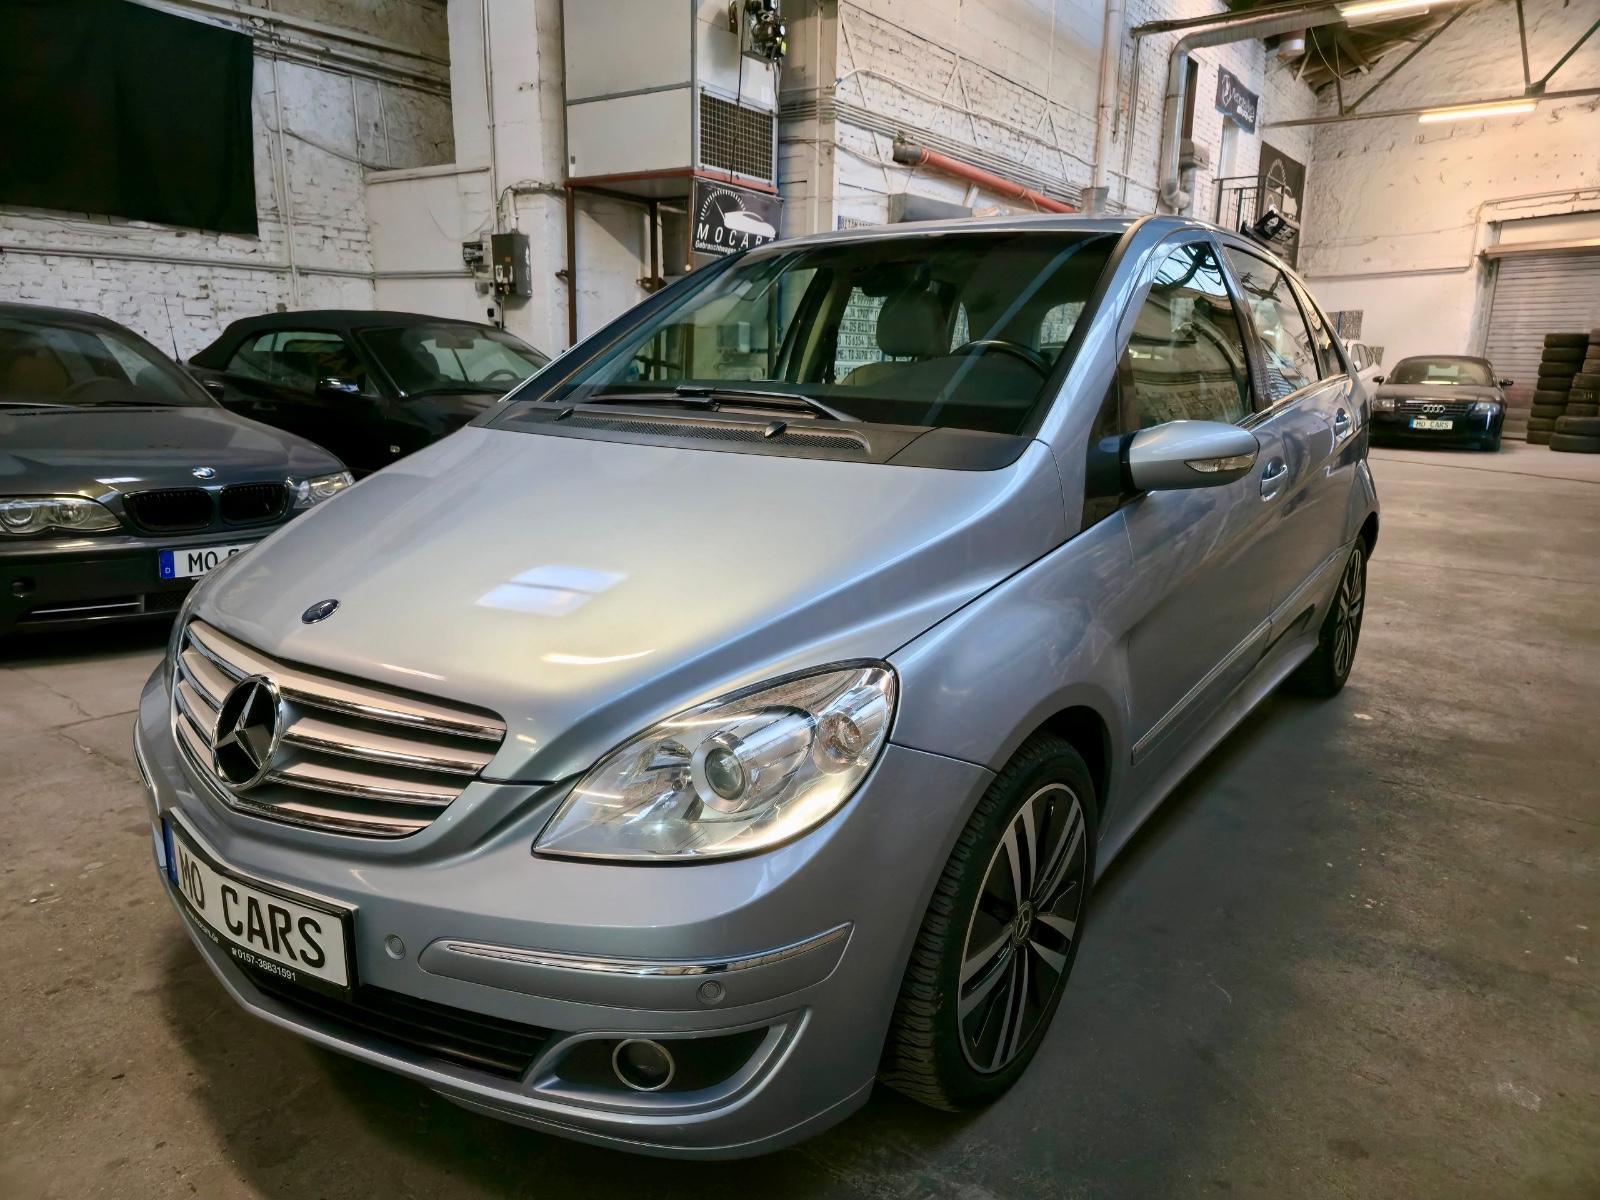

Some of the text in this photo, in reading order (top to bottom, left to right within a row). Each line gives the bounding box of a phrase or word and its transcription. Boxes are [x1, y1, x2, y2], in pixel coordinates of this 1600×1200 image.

[187, 551, 219, 573] MO
[178, 845, 205, 911] MO
[221, 884, 326, 969] CARS
